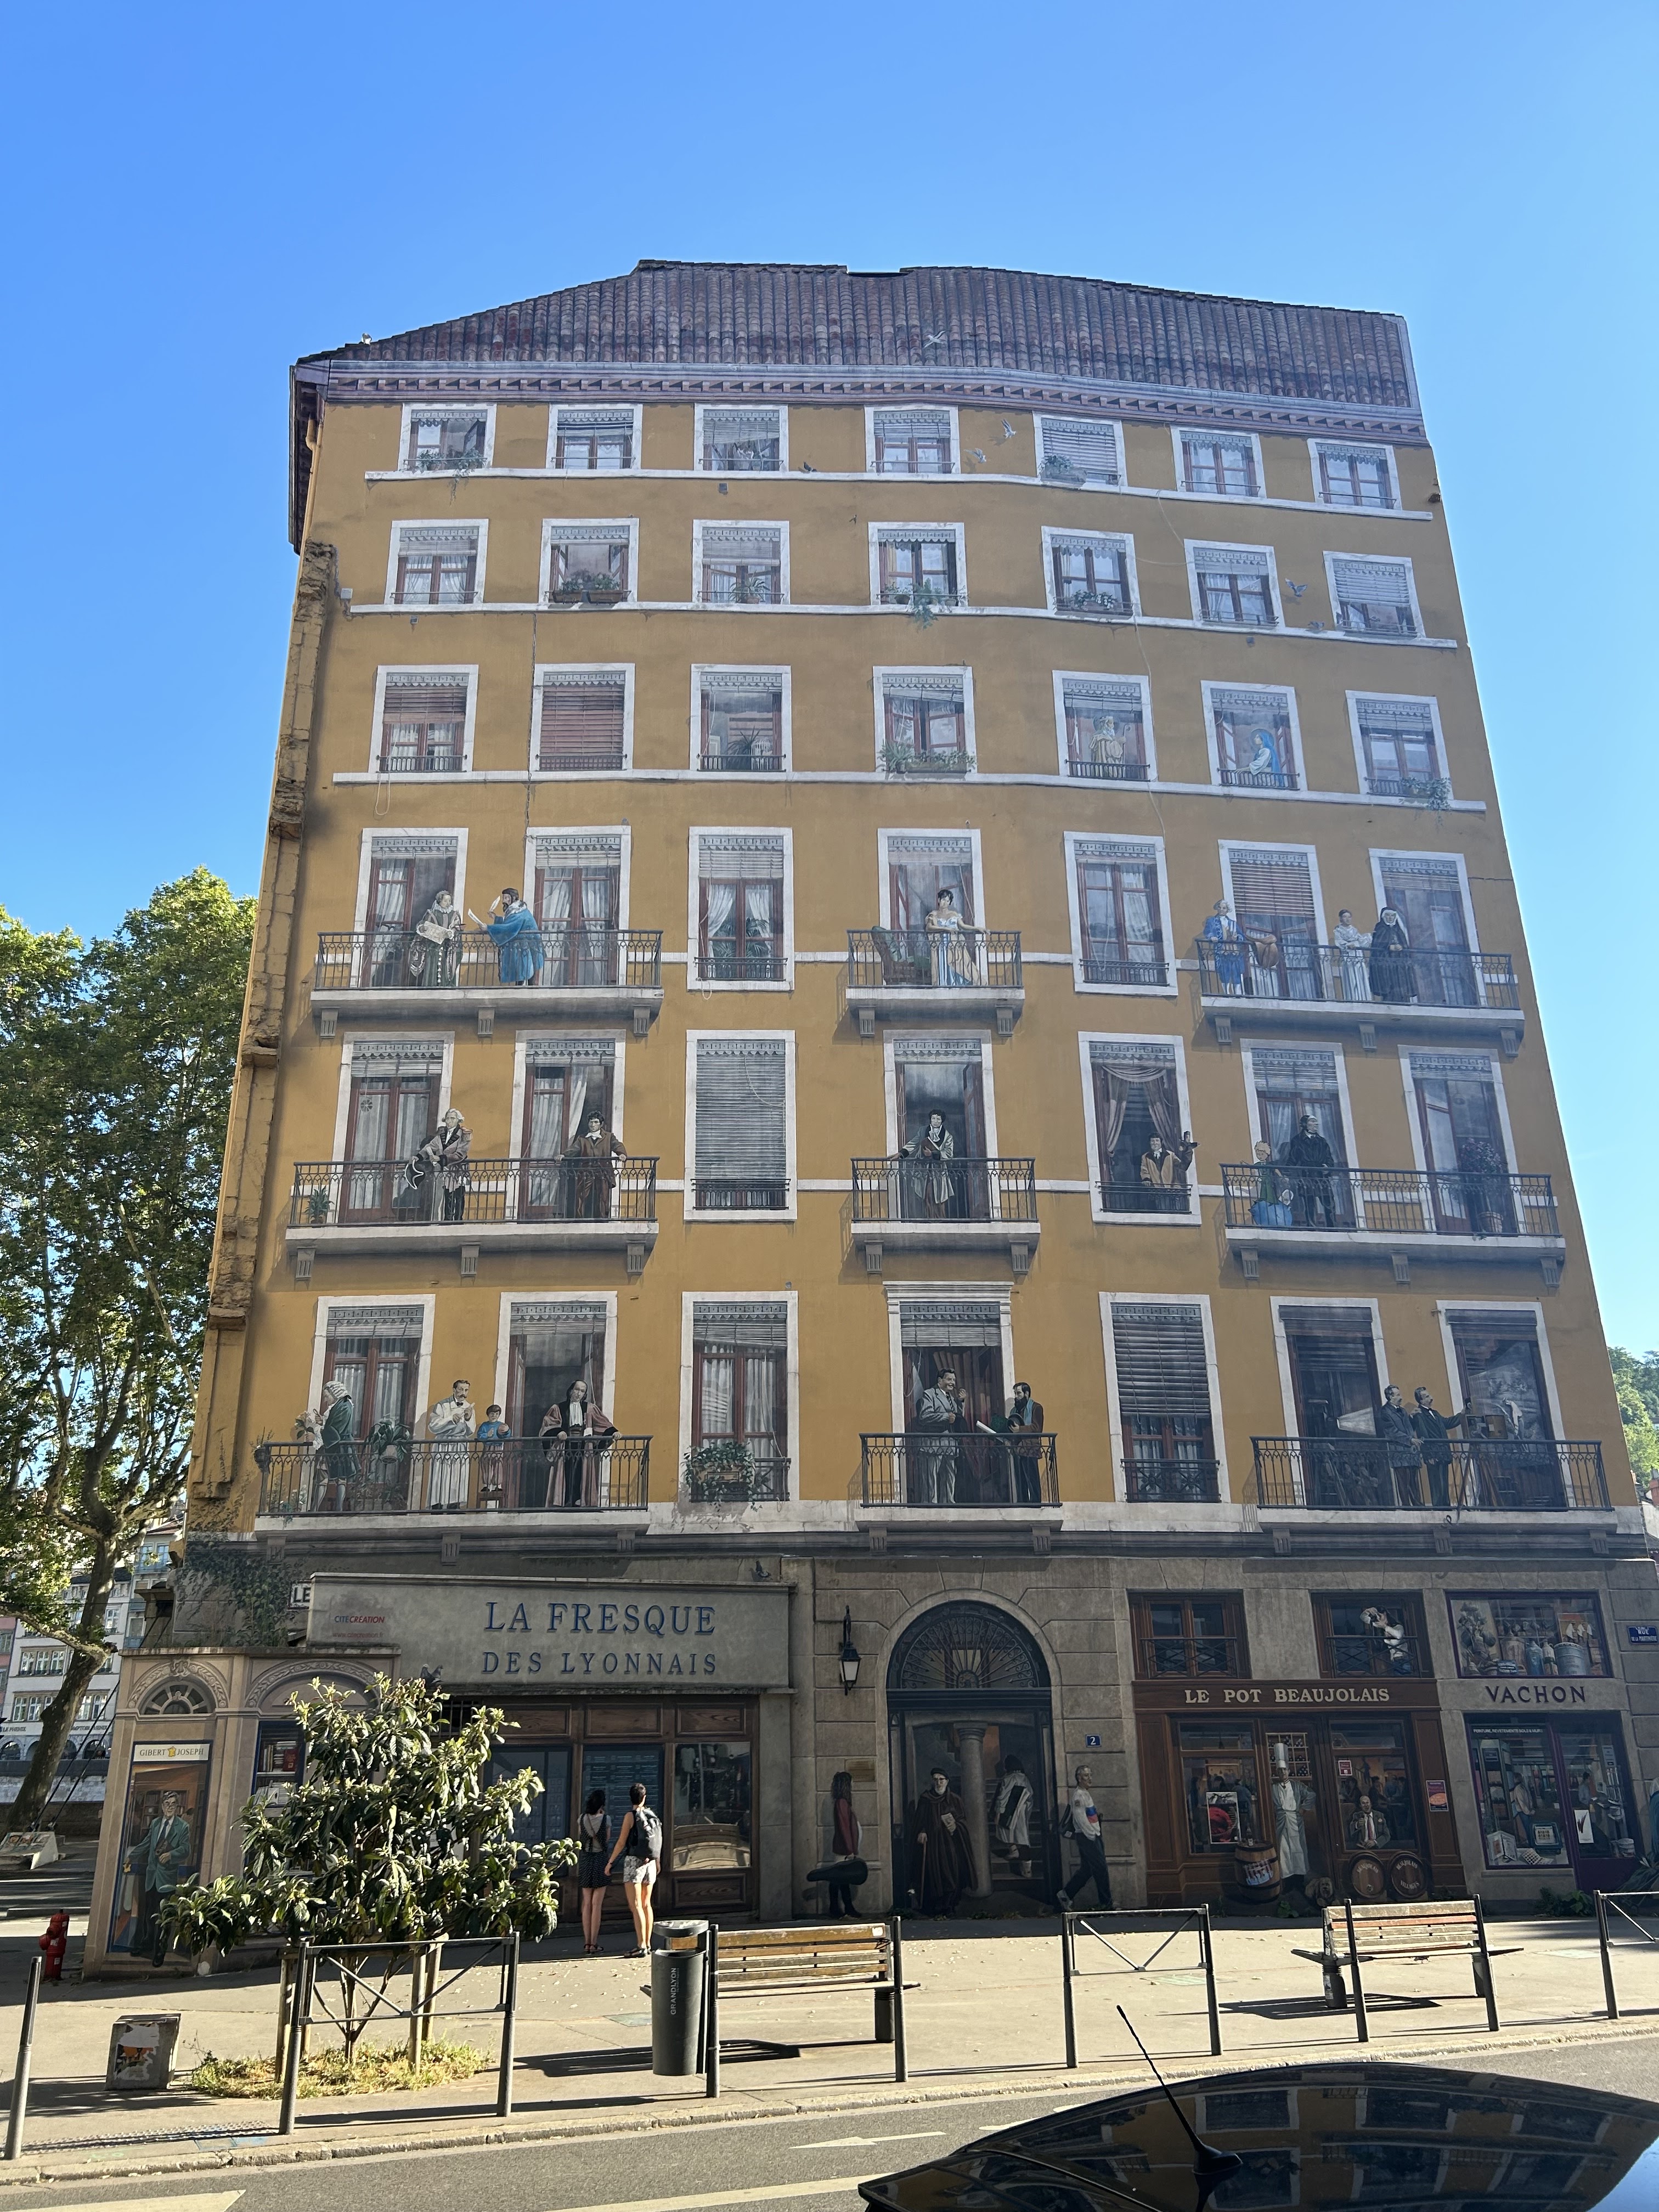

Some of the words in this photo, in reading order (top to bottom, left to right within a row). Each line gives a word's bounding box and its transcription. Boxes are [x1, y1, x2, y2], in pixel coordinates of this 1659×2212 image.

[484, 1602, 532, 1633] LA
[546, 1602, 716, 1638] FRESQUE
[481, 1652, 542, 1674] DES
[560, 1652, 716, 1675] LYONNAIS
[1184, 1689, 1210, 1703] LE
[1223, 1689, 1262, 1703] POT
[1273, 1688, 1390, 1703] BEAUJOLAIS
[1485, 1685, 1586, 1703] VACHON
[1090, 1736, 1096, 1745] 2
[1400, 1880, 1420, 1889] VILLAGES
